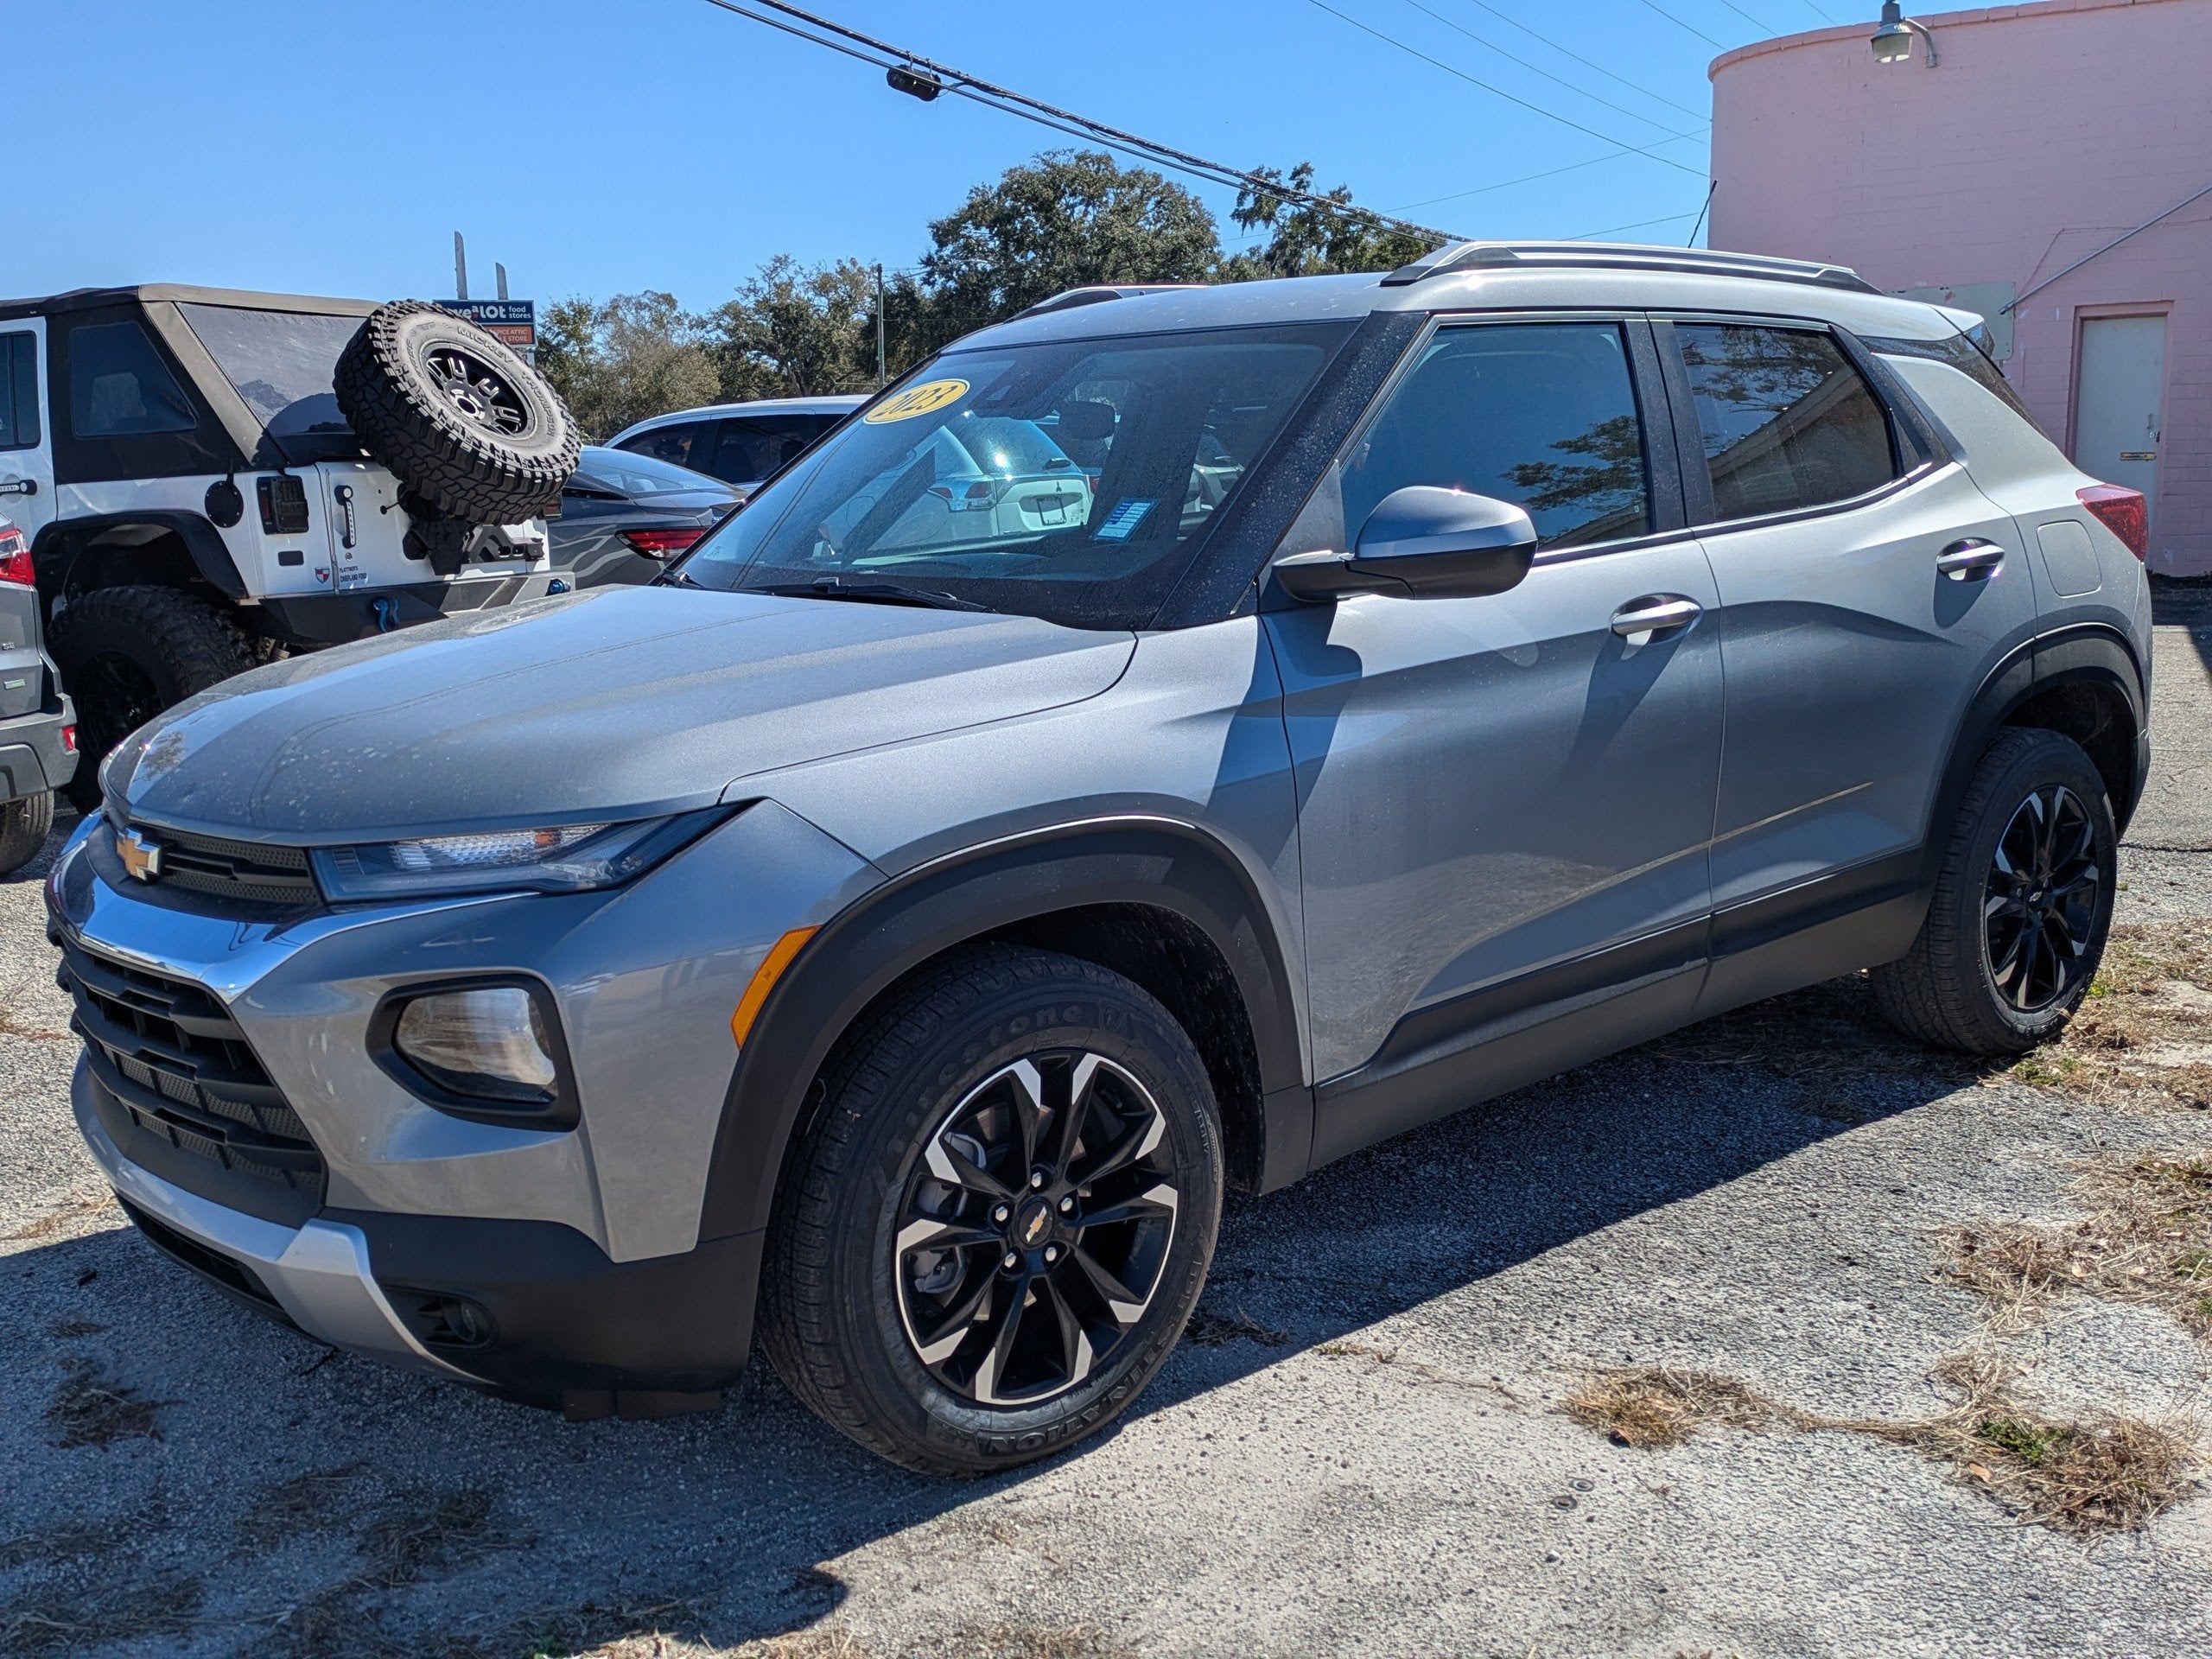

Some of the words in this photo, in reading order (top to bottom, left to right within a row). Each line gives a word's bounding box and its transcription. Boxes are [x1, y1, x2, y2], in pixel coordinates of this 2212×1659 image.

[457, 326, 514, 363] MICKEY
[521, 372, 556, 437] THOMPSON
[871, 385, 958, 417] 2023
